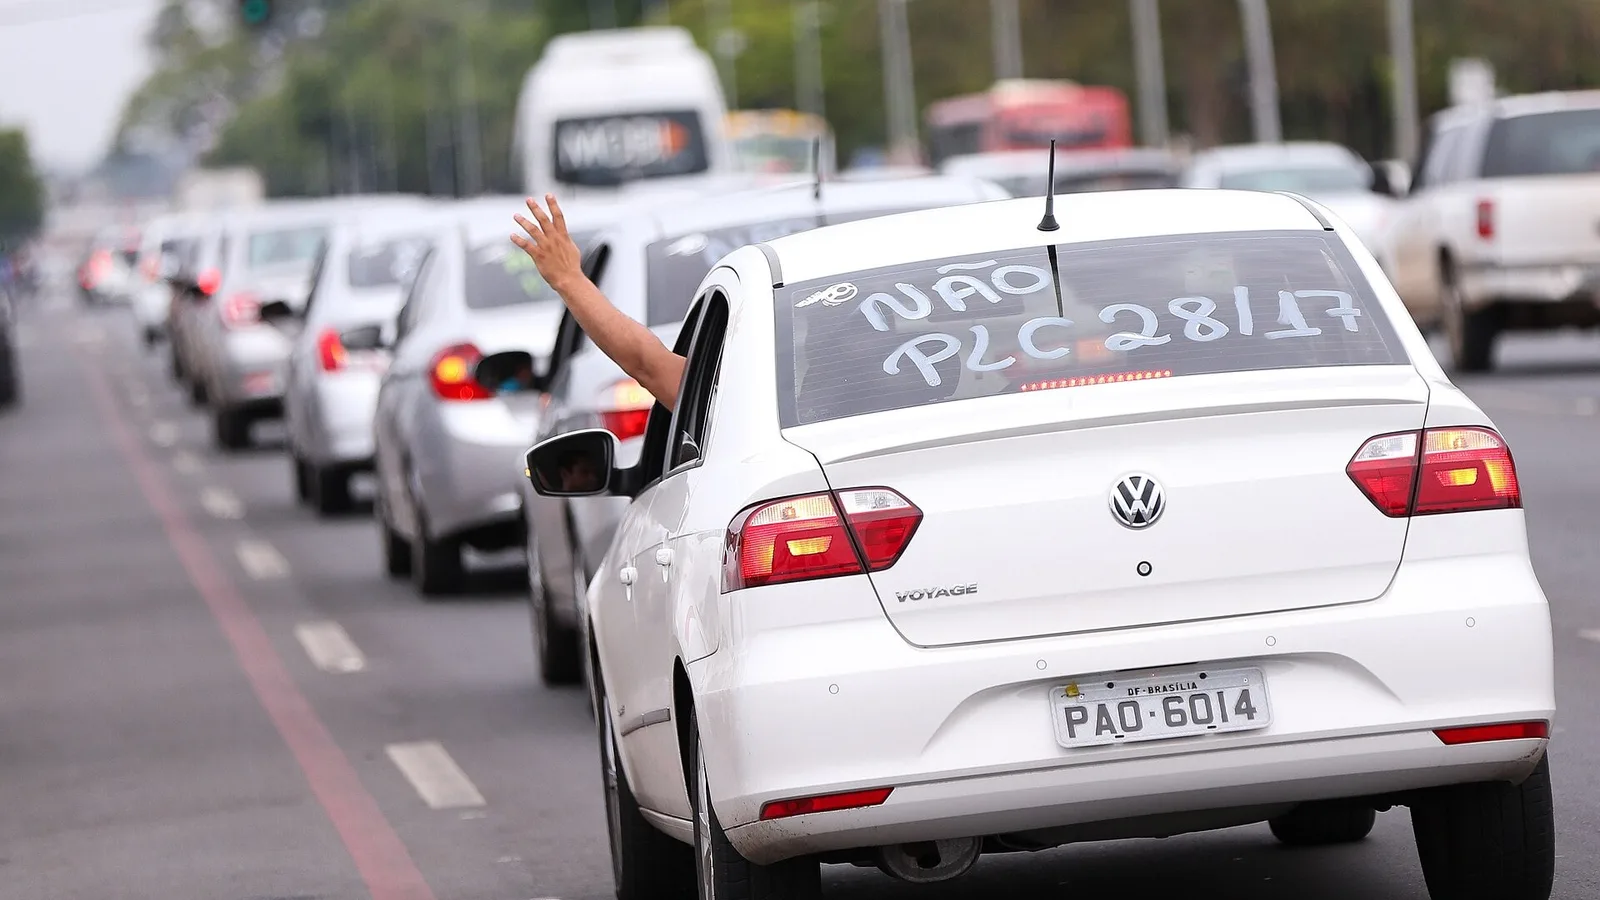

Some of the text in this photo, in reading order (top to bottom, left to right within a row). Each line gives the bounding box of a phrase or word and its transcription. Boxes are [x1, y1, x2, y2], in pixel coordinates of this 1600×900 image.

[859, 260, 1052, 331] NÃO
[883, 316, 1074, 386] PLC
[895, 582, 978, 603] VOYAGE
